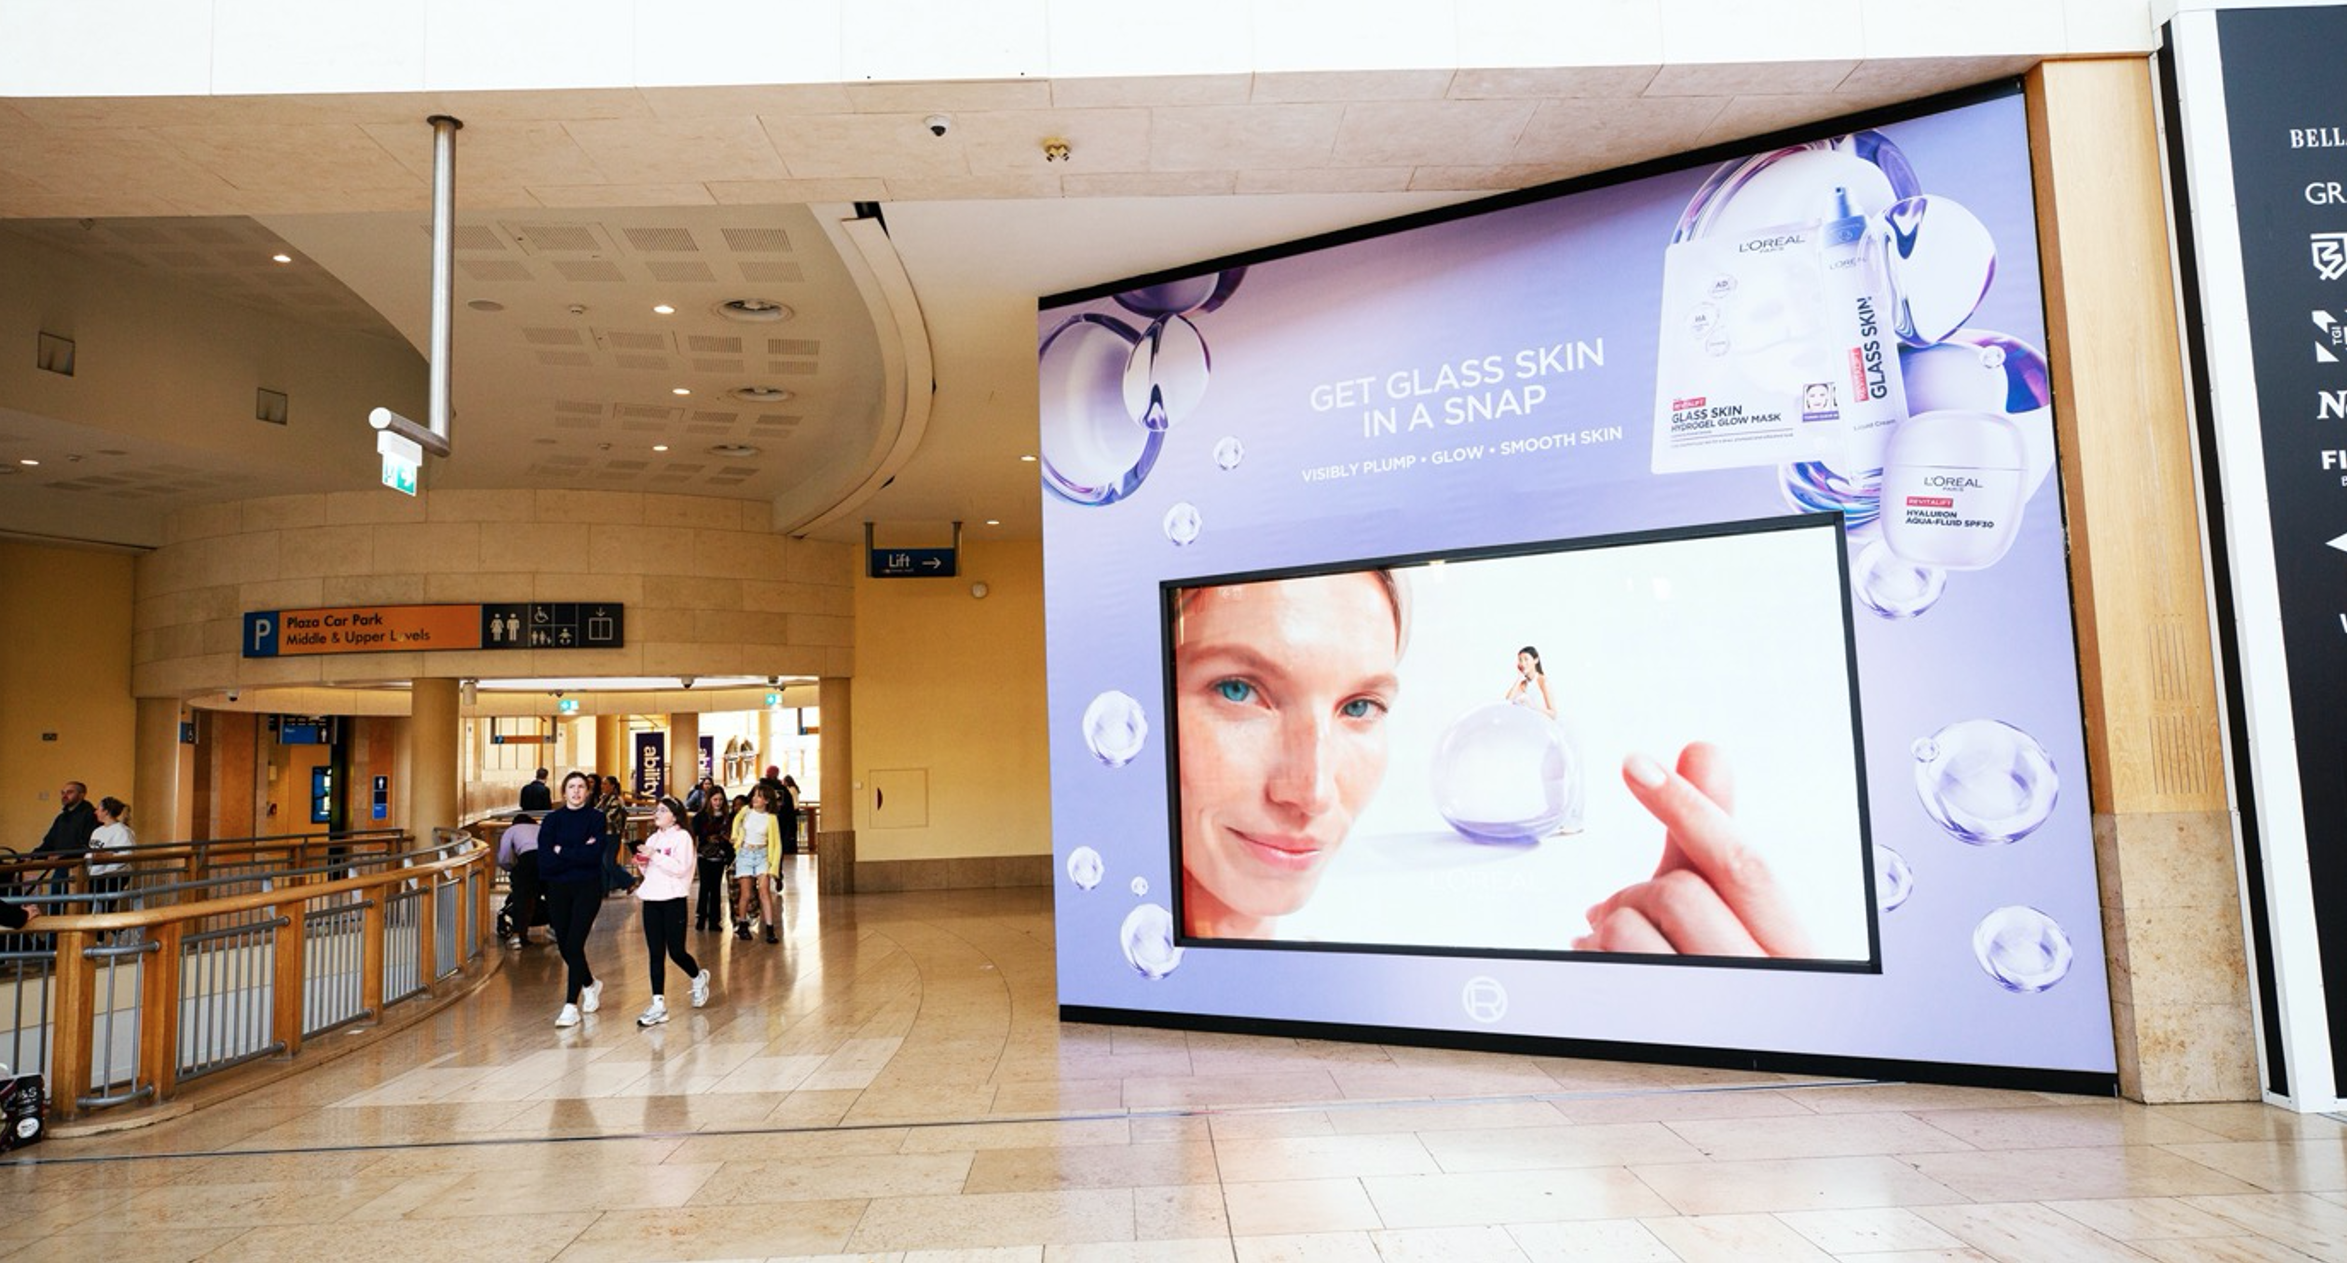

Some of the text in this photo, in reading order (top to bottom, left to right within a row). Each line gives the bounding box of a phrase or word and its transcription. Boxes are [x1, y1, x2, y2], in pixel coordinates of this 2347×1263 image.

[2289, 127, 2347, 149] BELL
[2305, 181, 2347, 206] GR
[2331, 326, 2343, 346] TGI
[1857, 297, 1888, 399] GLASS SKIN
[1310, 338, 1604, 412] GET GLASS SKIN
[1363, 385, 1546, 438] IN A SNAP
[1672, 405, 1742, 424] GLASS SKIN
[2317, 390, 2347, 420] N
[1671, 413, 1781, 433] HYDROGEL GLOW MASK
[1302, 426, 1623, 482] VISIBLY PLUMP GLOW SMOOTH SKIN
[1906, 509, 1957, 519] HYALURON
[1964, 520, 1994, 529] SPF30
[889, 554, 910, 567] Lift
[287, 613, 383, 629] Plaza Car Park
[255, 618, 271, 651] P
[287, 633, 327, 646] Middle
[331, 632, 341, 643] &
[345, 632, 385, 645] Upper
[640, 746, 661, 798] ability
